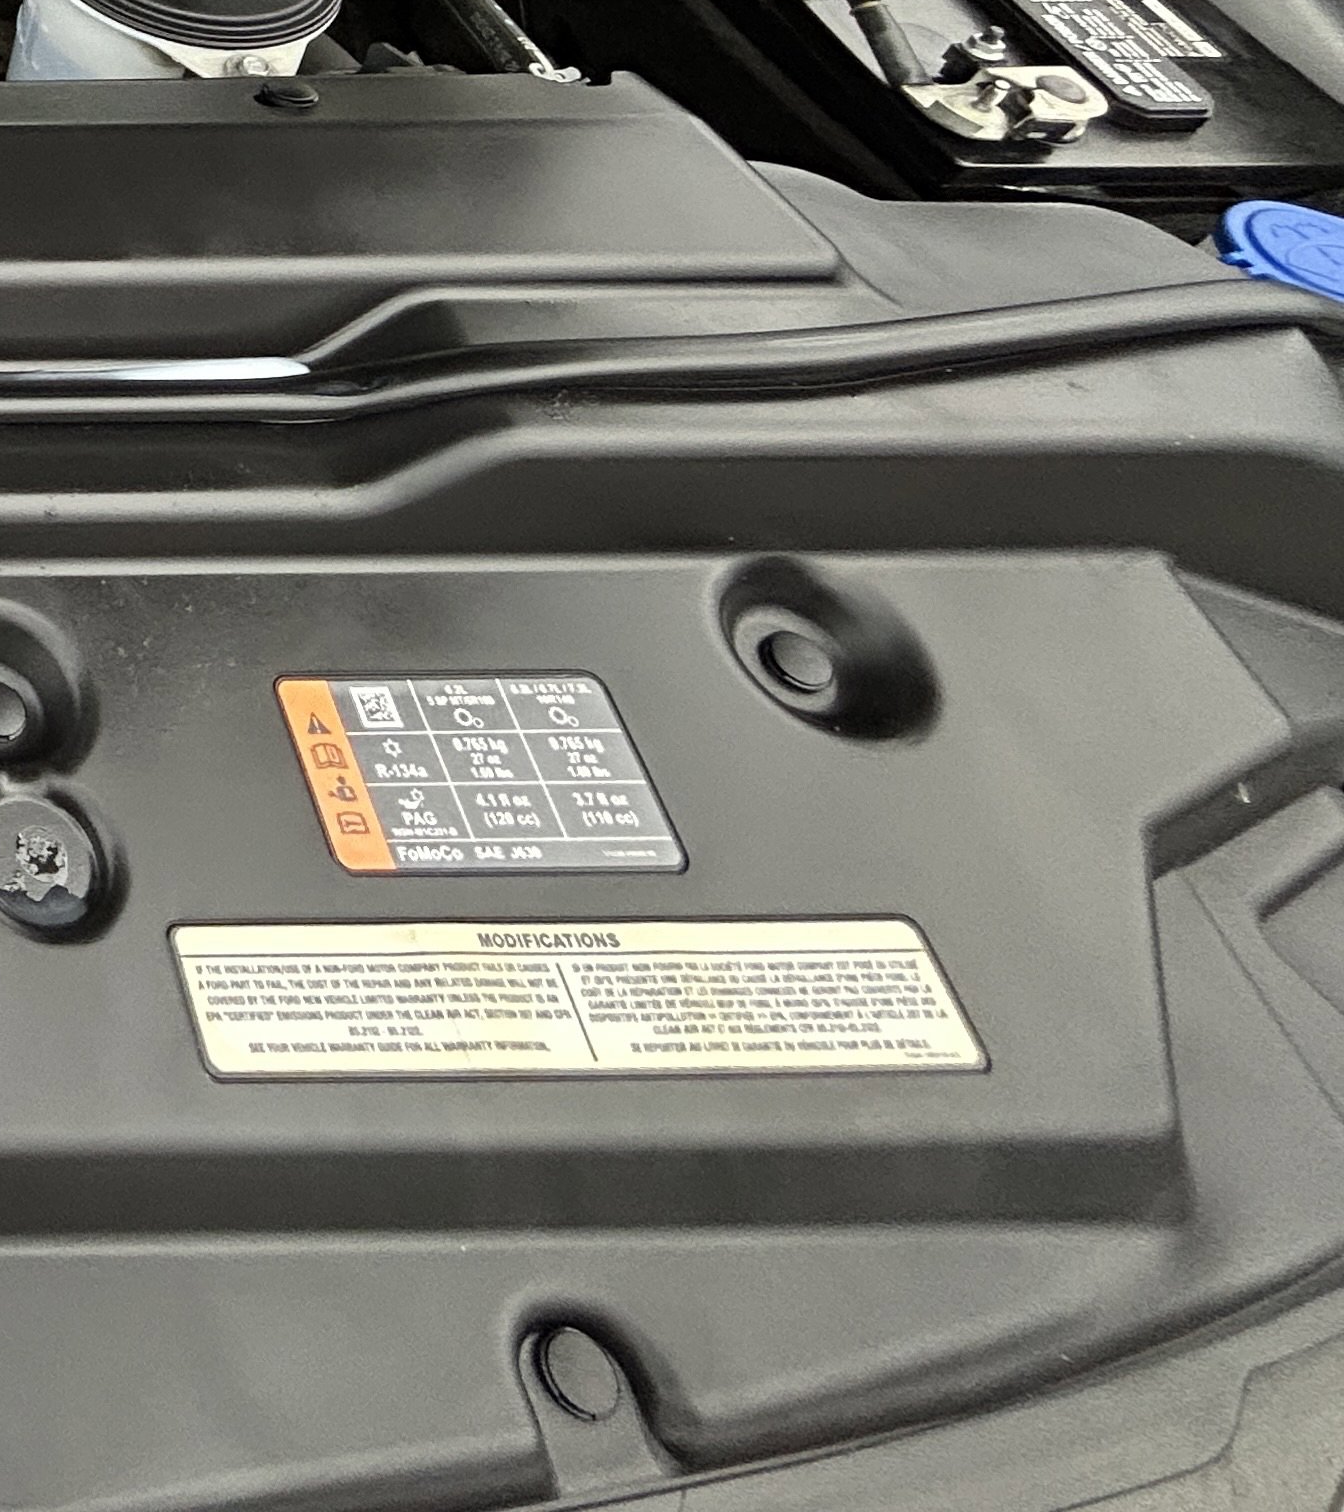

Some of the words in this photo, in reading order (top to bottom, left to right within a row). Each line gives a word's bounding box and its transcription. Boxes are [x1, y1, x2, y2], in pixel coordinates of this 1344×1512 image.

[488, 738, 509, 755] kg
[584, 737, 605, 754] kg
[470, 753, 484, 764] 27
[487, 754, 502, 765] oz
[567, 752, 581, 764] 27
[583, 753, 599, 764] oz
[375, 763, 429, 778] R-134a
[476, 793, 497, 807] 4.1
[513, 795, 532, 807] oz
[610, 794, 629, 806] oz
[401, 811, 438, 826] PAG
[483, 811, 514, 828] (120
[517, 812, 541, 828] cc)
[582, 810, 613, 827] (110
[615, 810, 640, 827] cc)
[396, 846, 463, 862] FoMoCo
[474, 846, 505, 861] SAE
[476, 932, 621, 948] MODIFICATIONS
